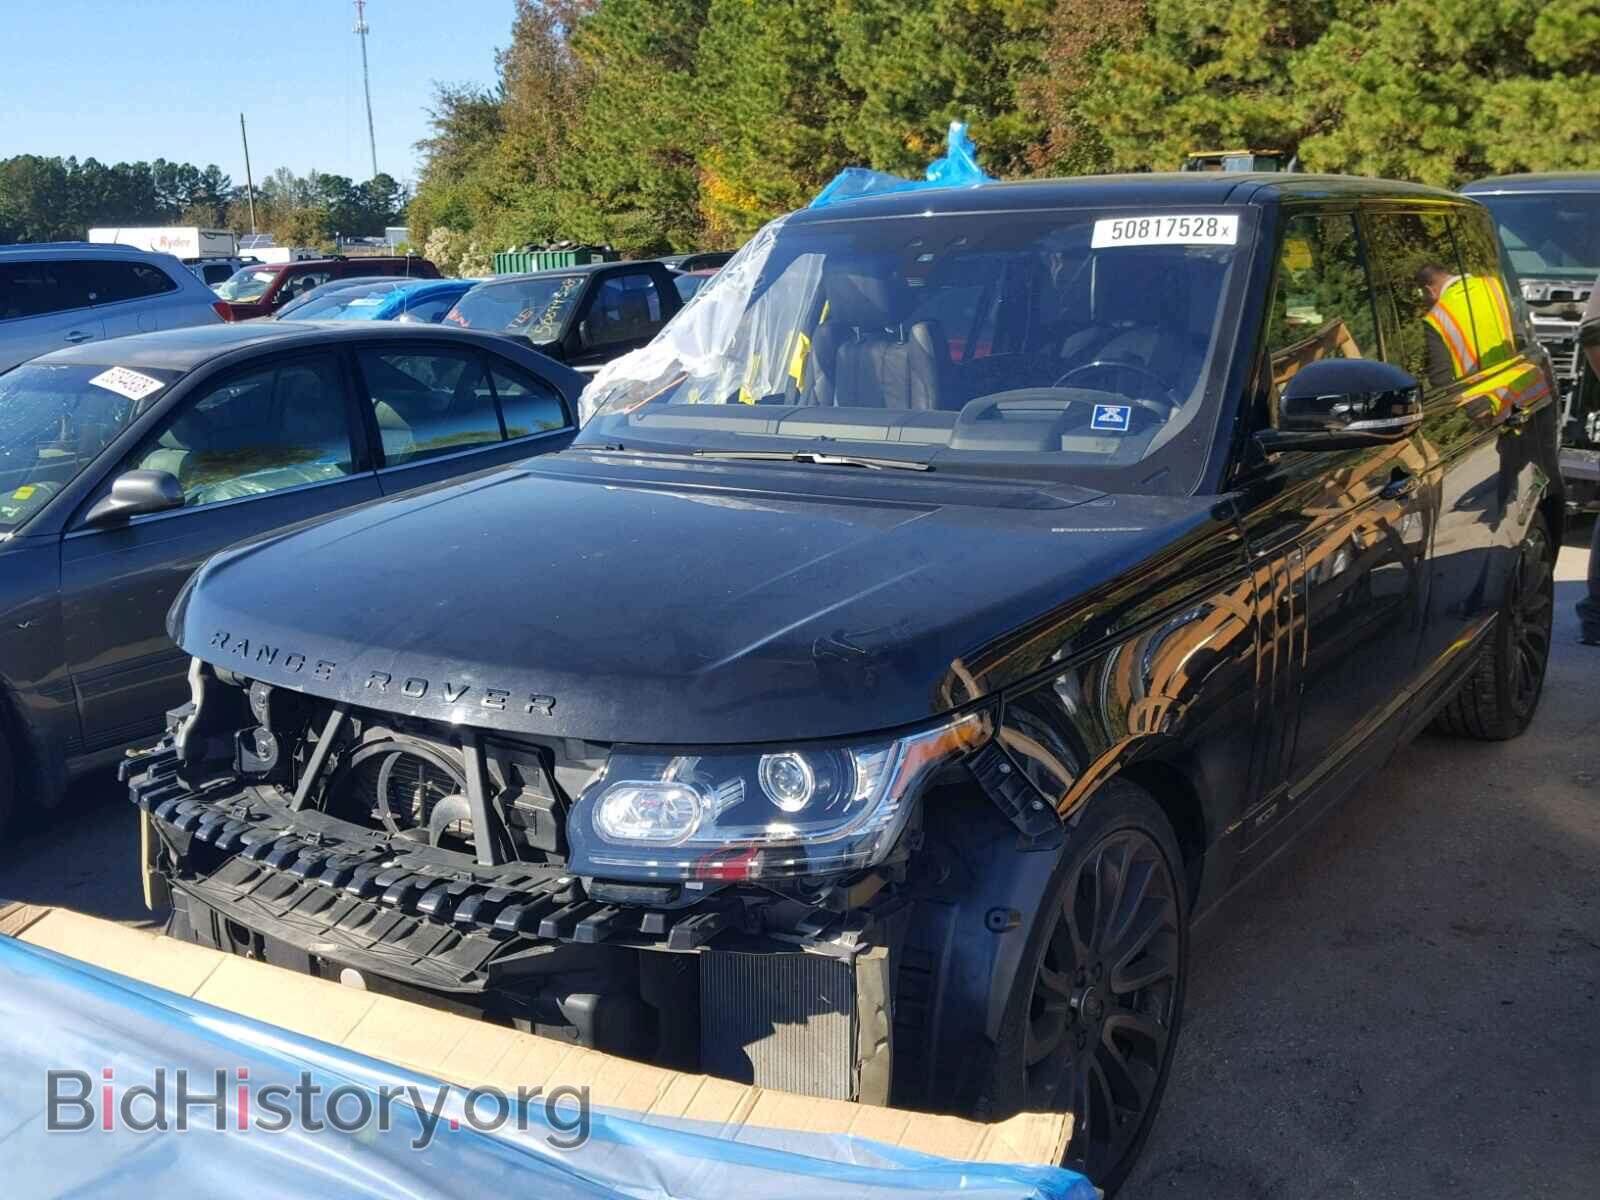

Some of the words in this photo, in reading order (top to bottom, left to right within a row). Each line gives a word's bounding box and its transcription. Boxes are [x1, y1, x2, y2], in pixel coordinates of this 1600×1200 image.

[1111, 218, 1218, 240] 50817528
[159, 237, 190, 248] Ryder
[210, 631, 336, 681] RANGE
[365, 671, 557, 717] ROVER
